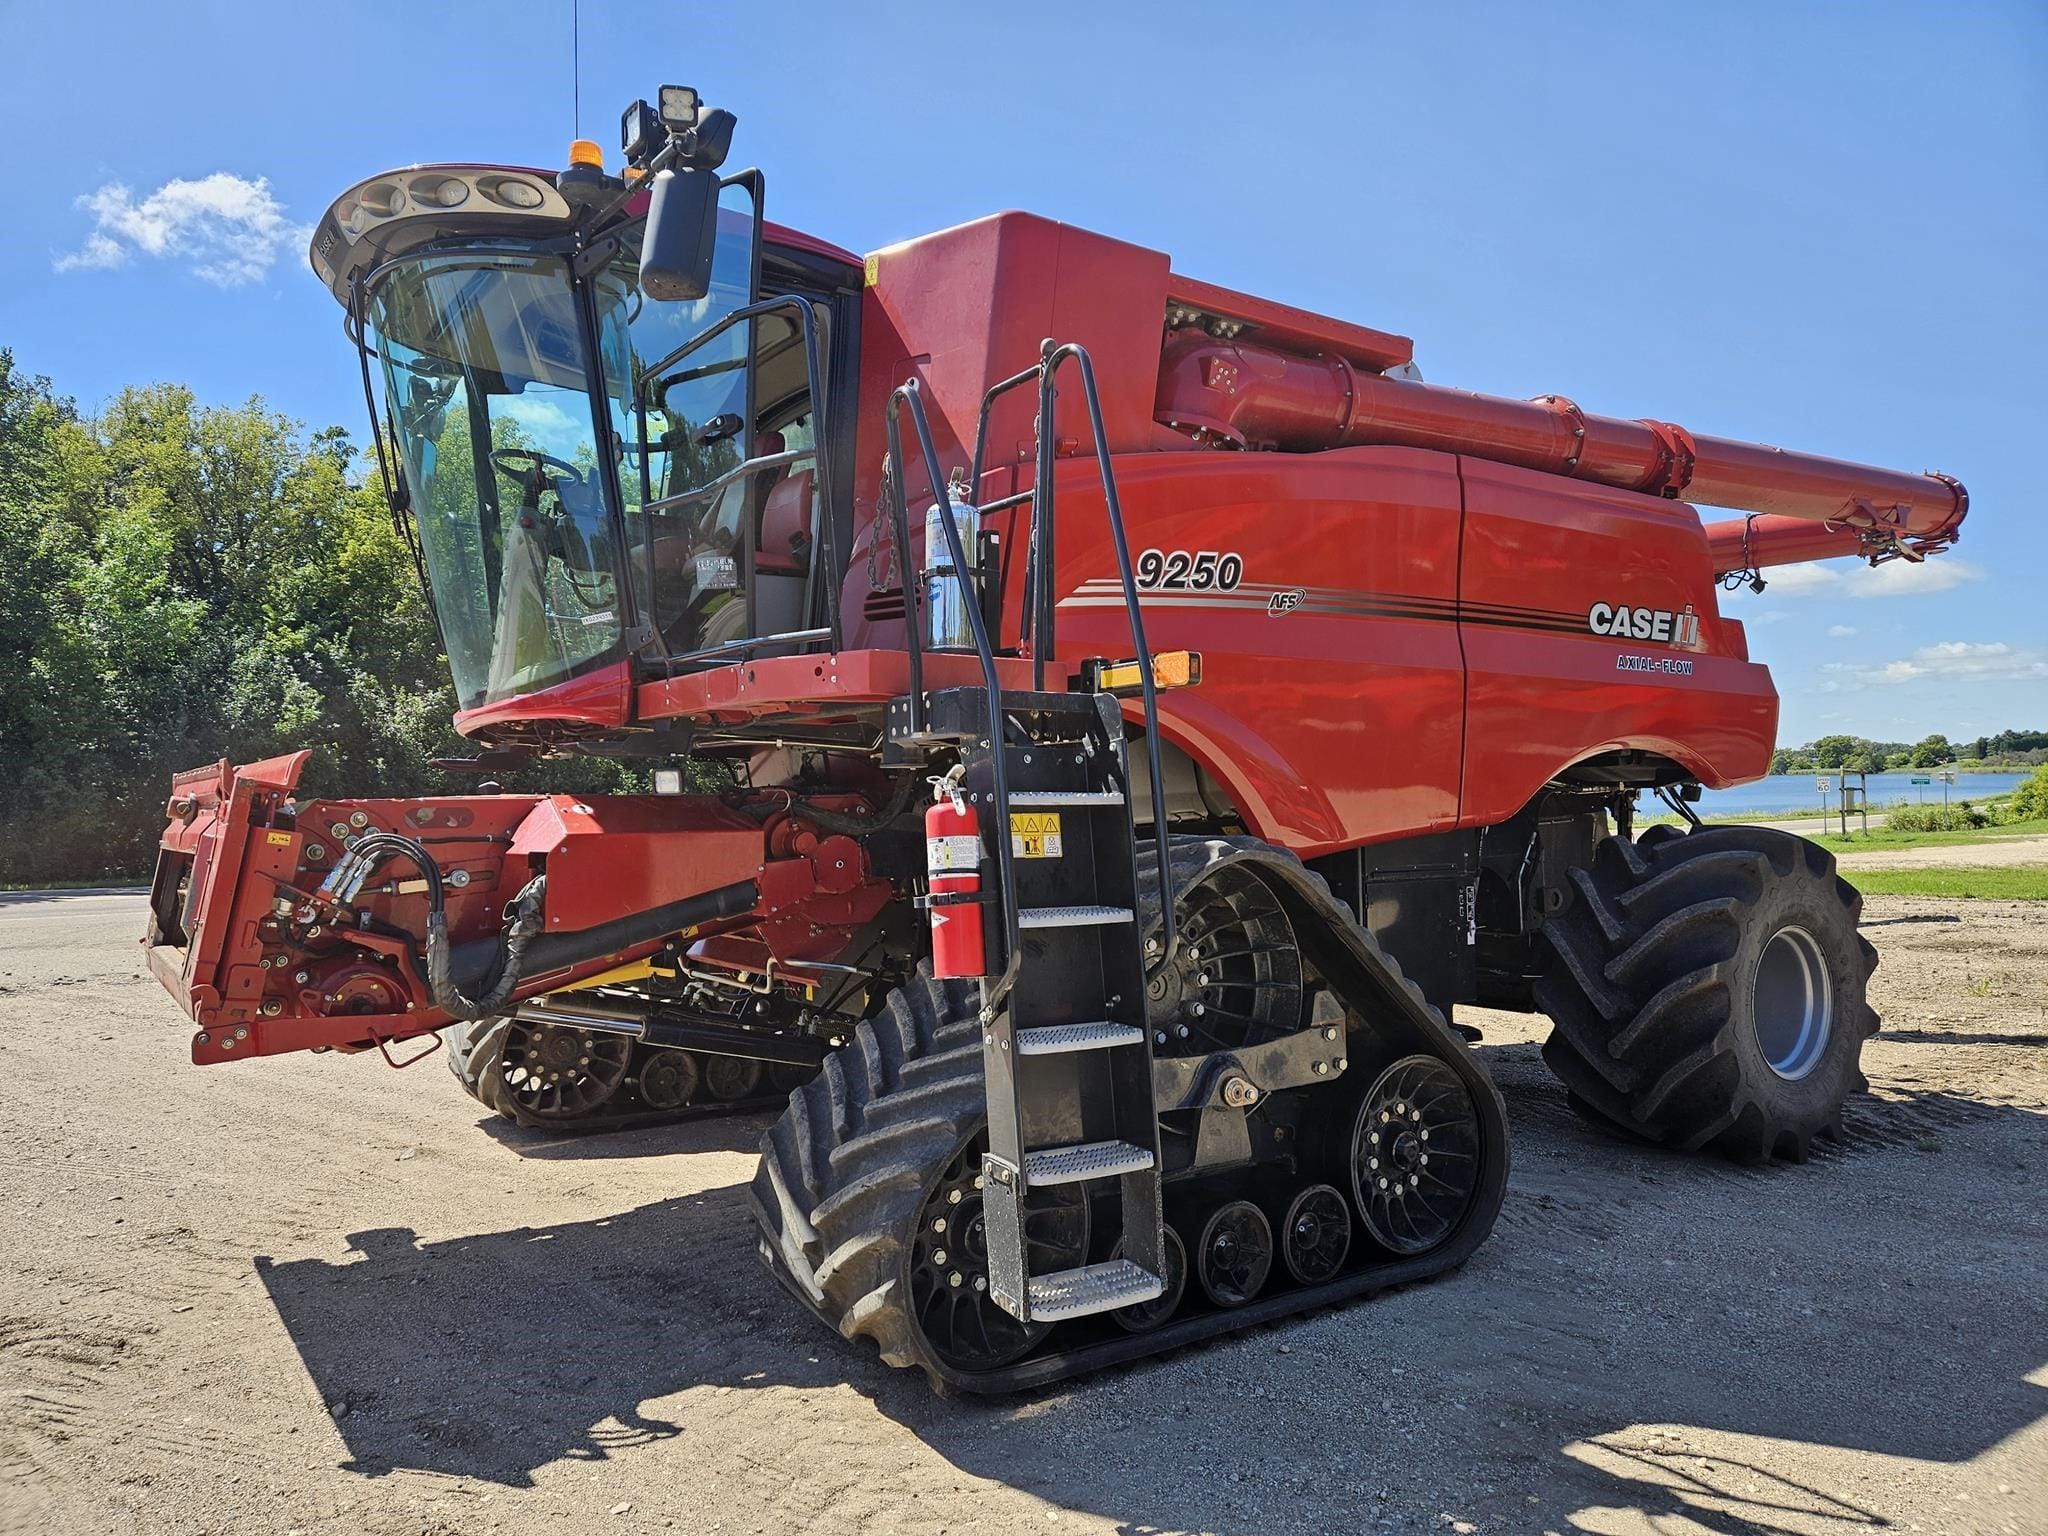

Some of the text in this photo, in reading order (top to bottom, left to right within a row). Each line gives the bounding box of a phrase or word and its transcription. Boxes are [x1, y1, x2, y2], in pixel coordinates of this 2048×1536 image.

[1136, 549, 1243, 592] 9250
[1268, 592, 1298, 610] AFS
[1588, 602, 1673, 641] CASE
[1616, 655, 1693, 675] AXIAL-FLOW
